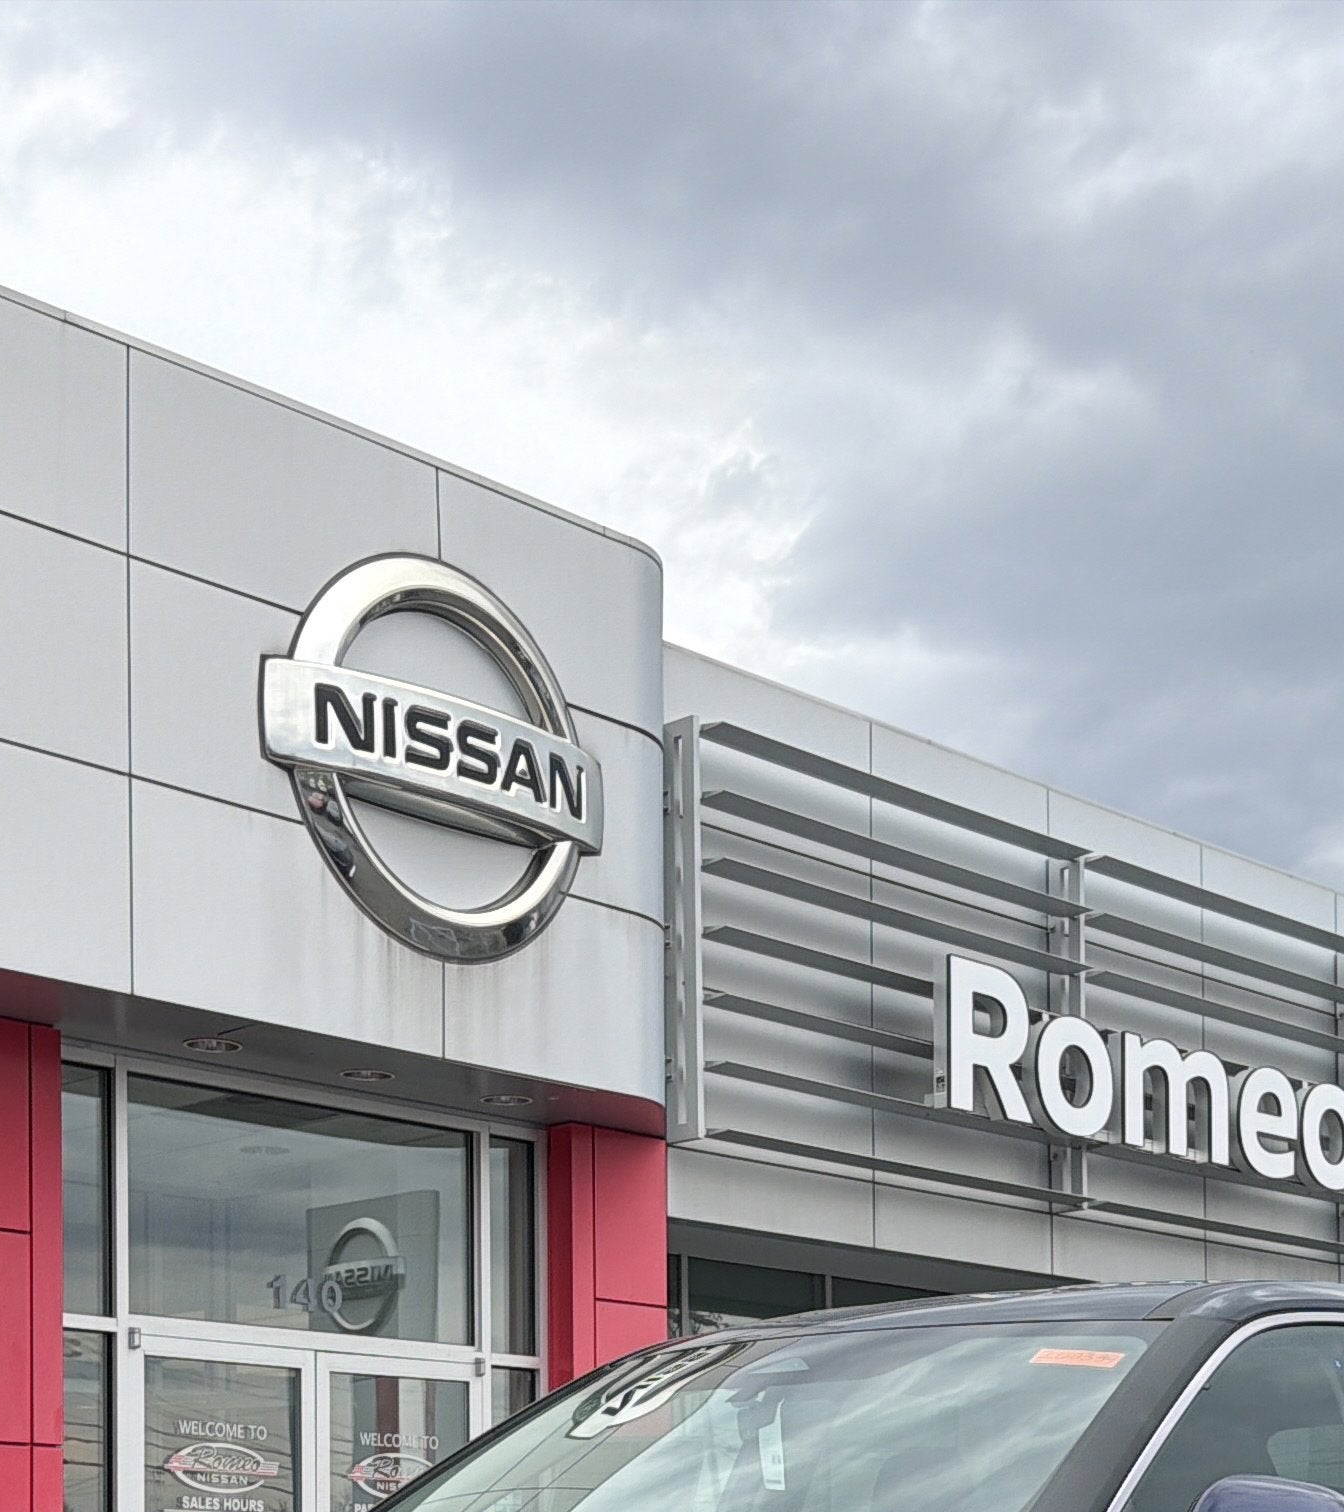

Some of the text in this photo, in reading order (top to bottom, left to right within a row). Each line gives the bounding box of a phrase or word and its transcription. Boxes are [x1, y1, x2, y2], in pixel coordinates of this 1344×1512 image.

[314, 683, 584, 822] NISSAN
[267, 1274, 343, 1314] 140
[178, 1419, 268, 1440] WELCOME TO
[359, 1431, 439, 1450] WELCOME TO
[186, 1446, 261, 1472] Romeo
[197, 1473, 248, 1486] NISSAN
[182, 1496, 265, 1512] SALES HOURS
